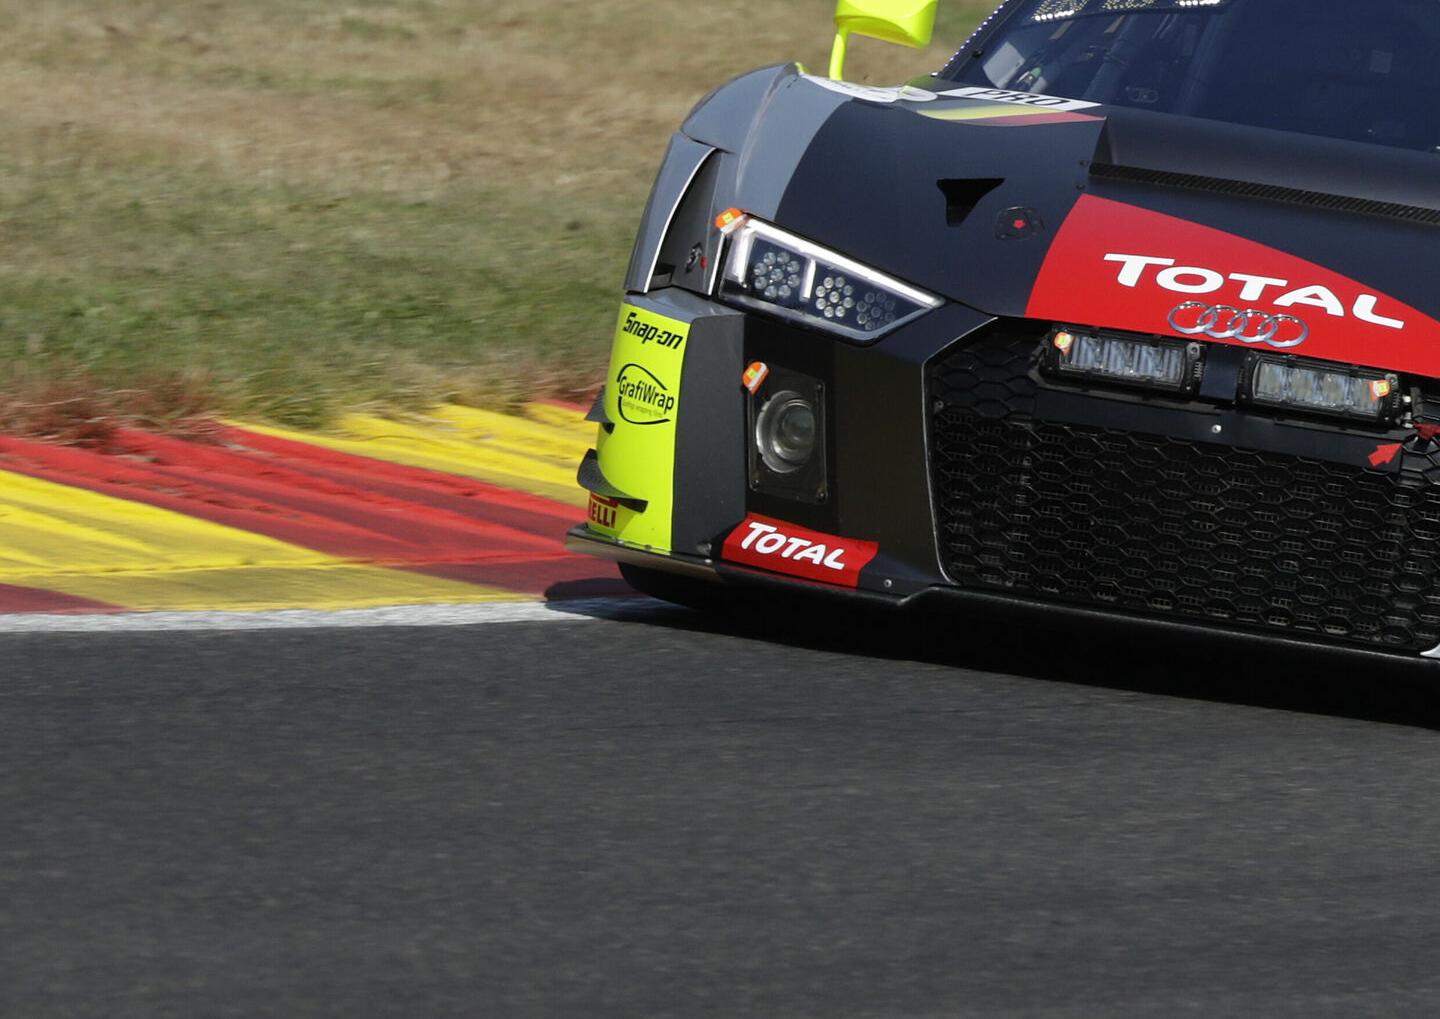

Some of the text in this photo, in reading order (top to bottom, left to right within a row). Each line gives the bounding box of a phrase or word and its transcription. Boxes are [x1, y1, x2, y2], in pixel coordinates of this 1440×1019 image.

[963, 89, 1071, 107] PRO
[1103, 253, 1405, 329] TOTAL
[622, 311, 684, 350] Snap-on
[619, 375, 675, 414] GrafiWrap
[740, 521, 846, 570] TOTAL
